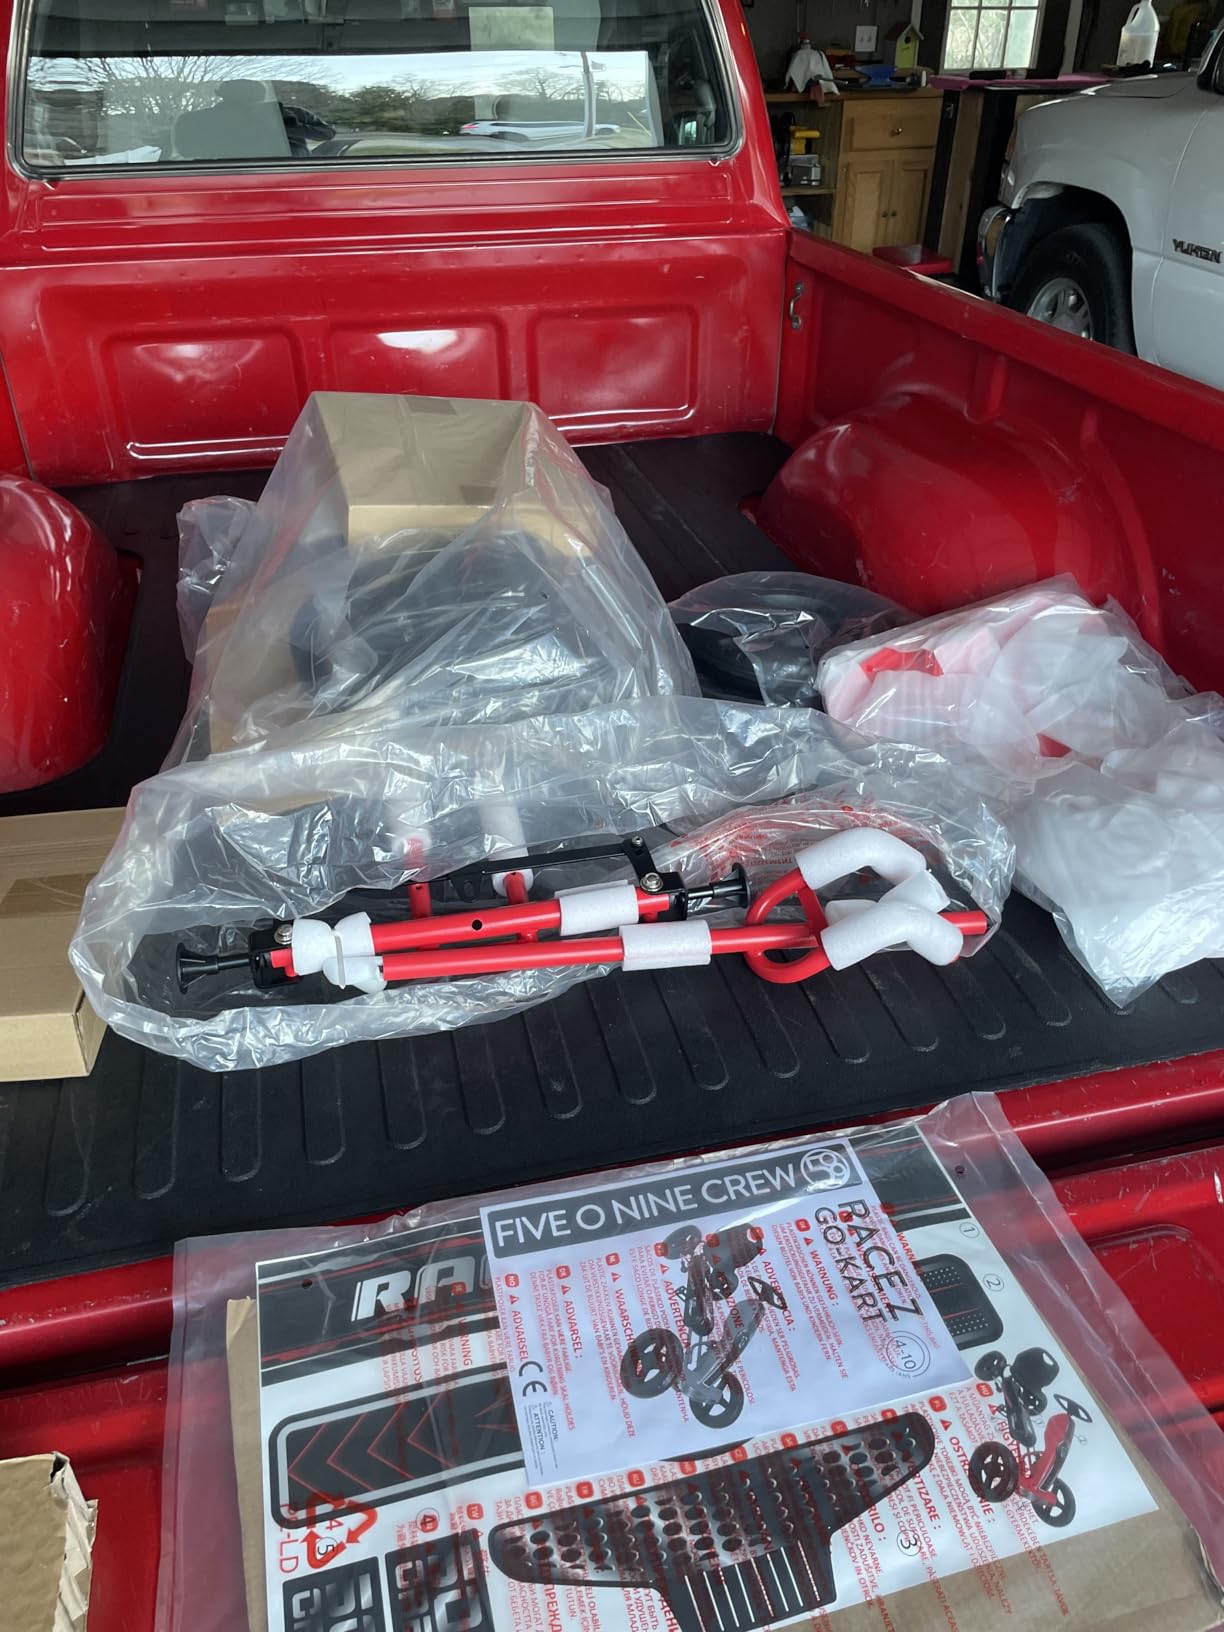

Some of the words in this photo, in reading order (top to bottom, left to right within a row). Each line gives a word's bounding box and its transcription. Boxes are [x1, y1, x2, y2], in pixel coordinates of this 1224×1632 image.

[494, 1209, 571, 1247] FIVE
[575, 1204, 604, 1230] O
[613, 1184, 698, 1224] NINE
[701, 1163, 796, 1204] CREW
[808, 1250, 838, 1300] WARNUNG
[810, 1205, 888, 1327] GO-KART
[835, 1198, 909, 1293] RACE
[885, 1297, 924, 1323] Z
[562, 1299, 583, 1353] ADVARSEL
[715, 1270, 744, 1328] ANZIONE
[457, 1317, 472, 1367] VRNING
[511, 1308, 529, 1362] ADVARSEL
[891, 1338, 917, 1370] 4-10
[532, 1412, 545, 1450] ATTENTION
[899, 1448, 940, 1522] VERTIZARE
[947, 1435, 995, 1515] OSTRNIE
